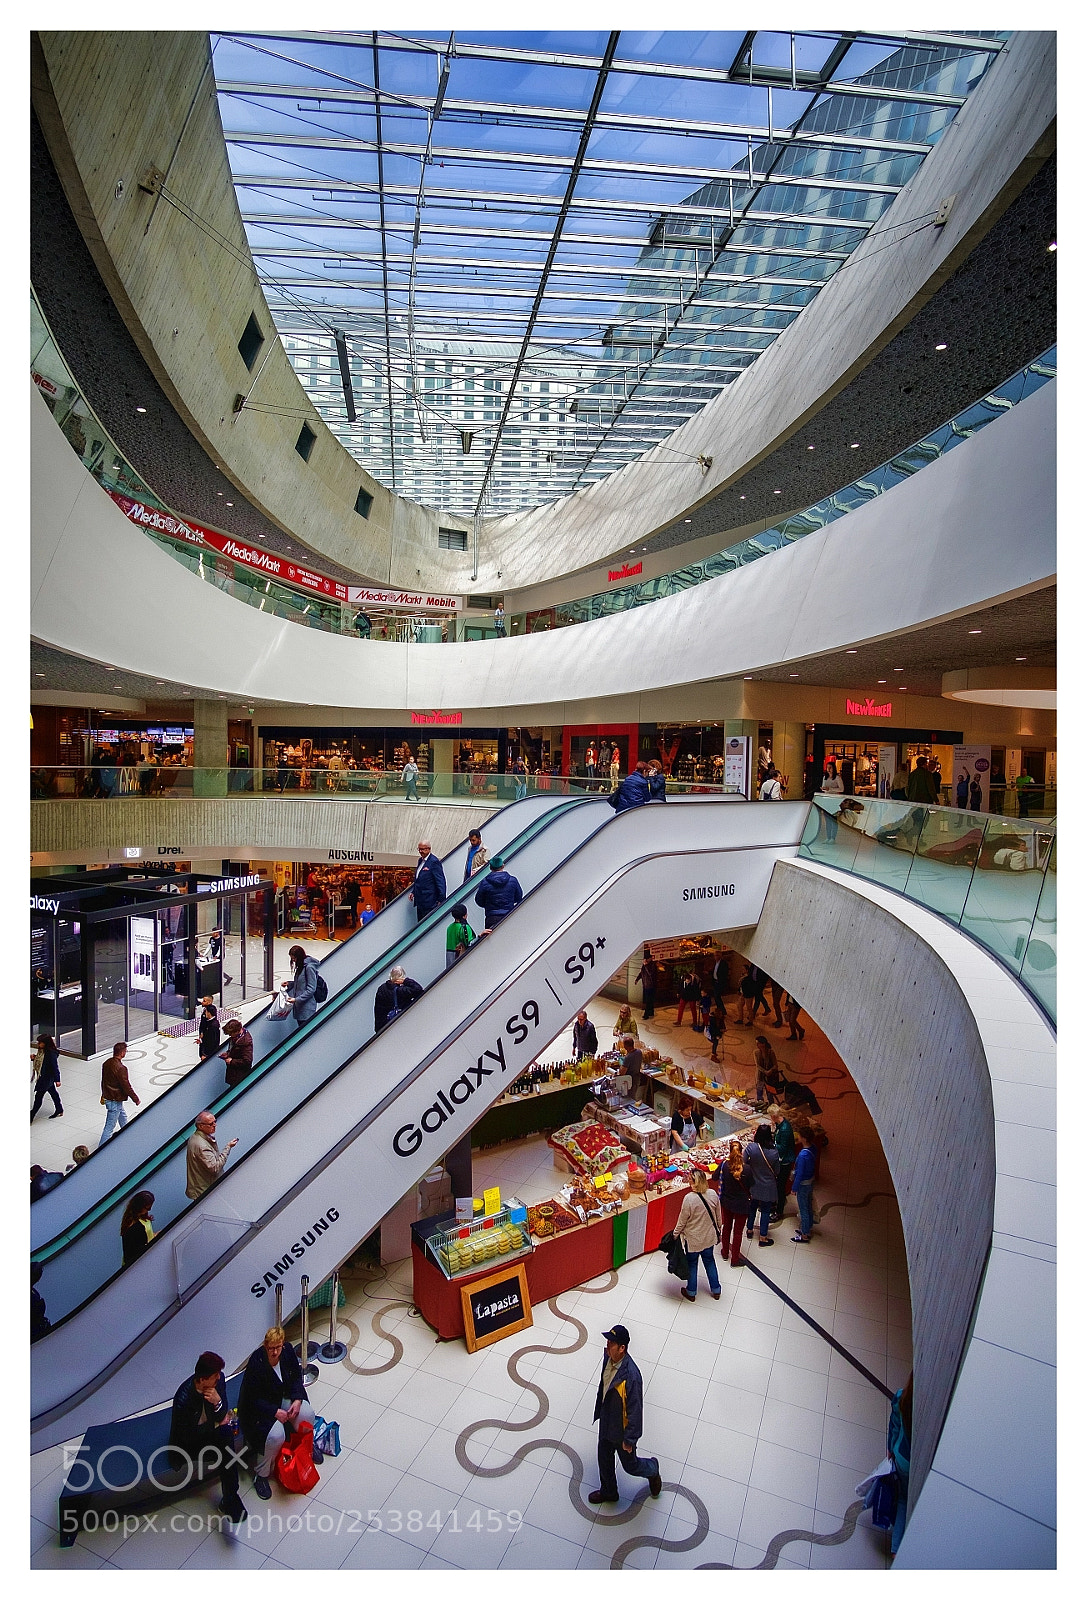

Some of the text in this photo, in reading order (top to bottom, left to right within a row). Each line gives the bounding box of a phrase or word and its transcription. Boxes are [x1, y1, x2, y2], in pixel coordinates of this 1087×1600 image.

[356, 590, 388, 602] Media
[394, 593, 423, 605] Markt
[426, 597, 456, 608] Mobile
[328, 849, 375, 862] AUSGANG
[210, 874, 260, 894] SAMSUNG
[682, 883, 735, 902] SAMSUNG
[392, 1036, 507, 1158] Galaxy
[505, 999, 540, 1045] S9
[564, 936, 607, 985] S9+
[250, 1207, 340, 1299] SAMSUNG
